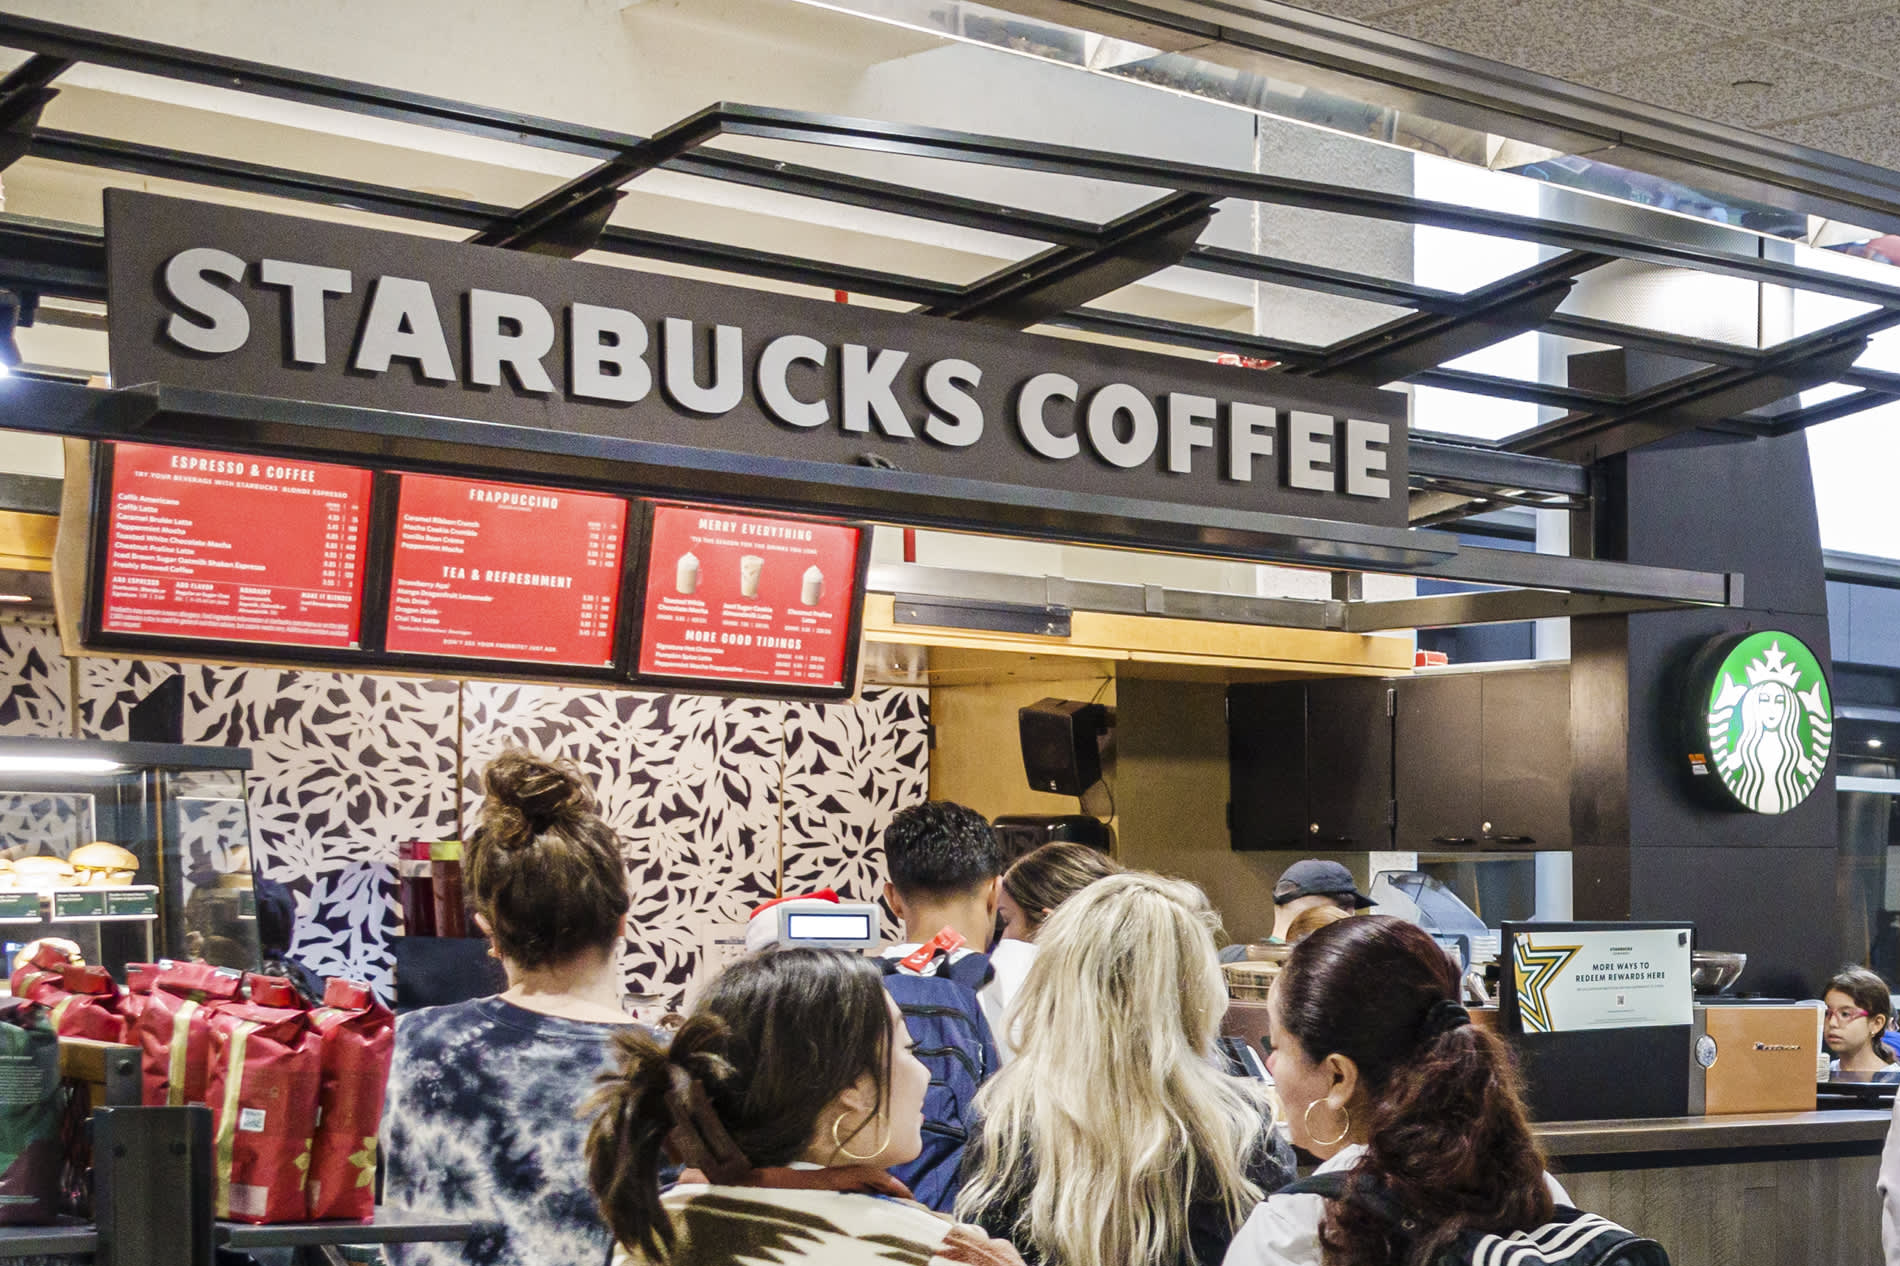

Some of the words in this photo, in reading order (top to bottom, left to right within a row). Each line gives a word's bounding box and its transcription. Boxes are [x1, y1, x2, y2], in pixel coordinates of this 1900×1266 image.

[165, 247, 985, 447] STARBUCKS
[1016, 373, 1391, 499] COFFEE
[172, 455, 244, 475] ESPRESSO
[250, 464, 260, 477] &
[266, 465, 315, 483] COFFEE
[469, 488, 558, 510] FRAPPUCCINO
[698, 518, 737, 533] MERRY
[741, 523, 813, 542] EVERYTHING
[443, 565, 466, 579] TEA
[471, 568, 480, 581] &
[486, 570, 572, 589] REFRESHMENT
[685, 629, 717, 643] MORE
[721, 632, 752, 646] GOOD
[756, 635, 802, 650] TIDINGS
[1575, 973, 1606, 982] REDEEM
[1608, 972, 1645, 981] REWARDS
[1646, 971, 1665, 980] HERE
[1592, 963, 1615, 971] MORE
[1617, 962, 1639, 970] WAYS
